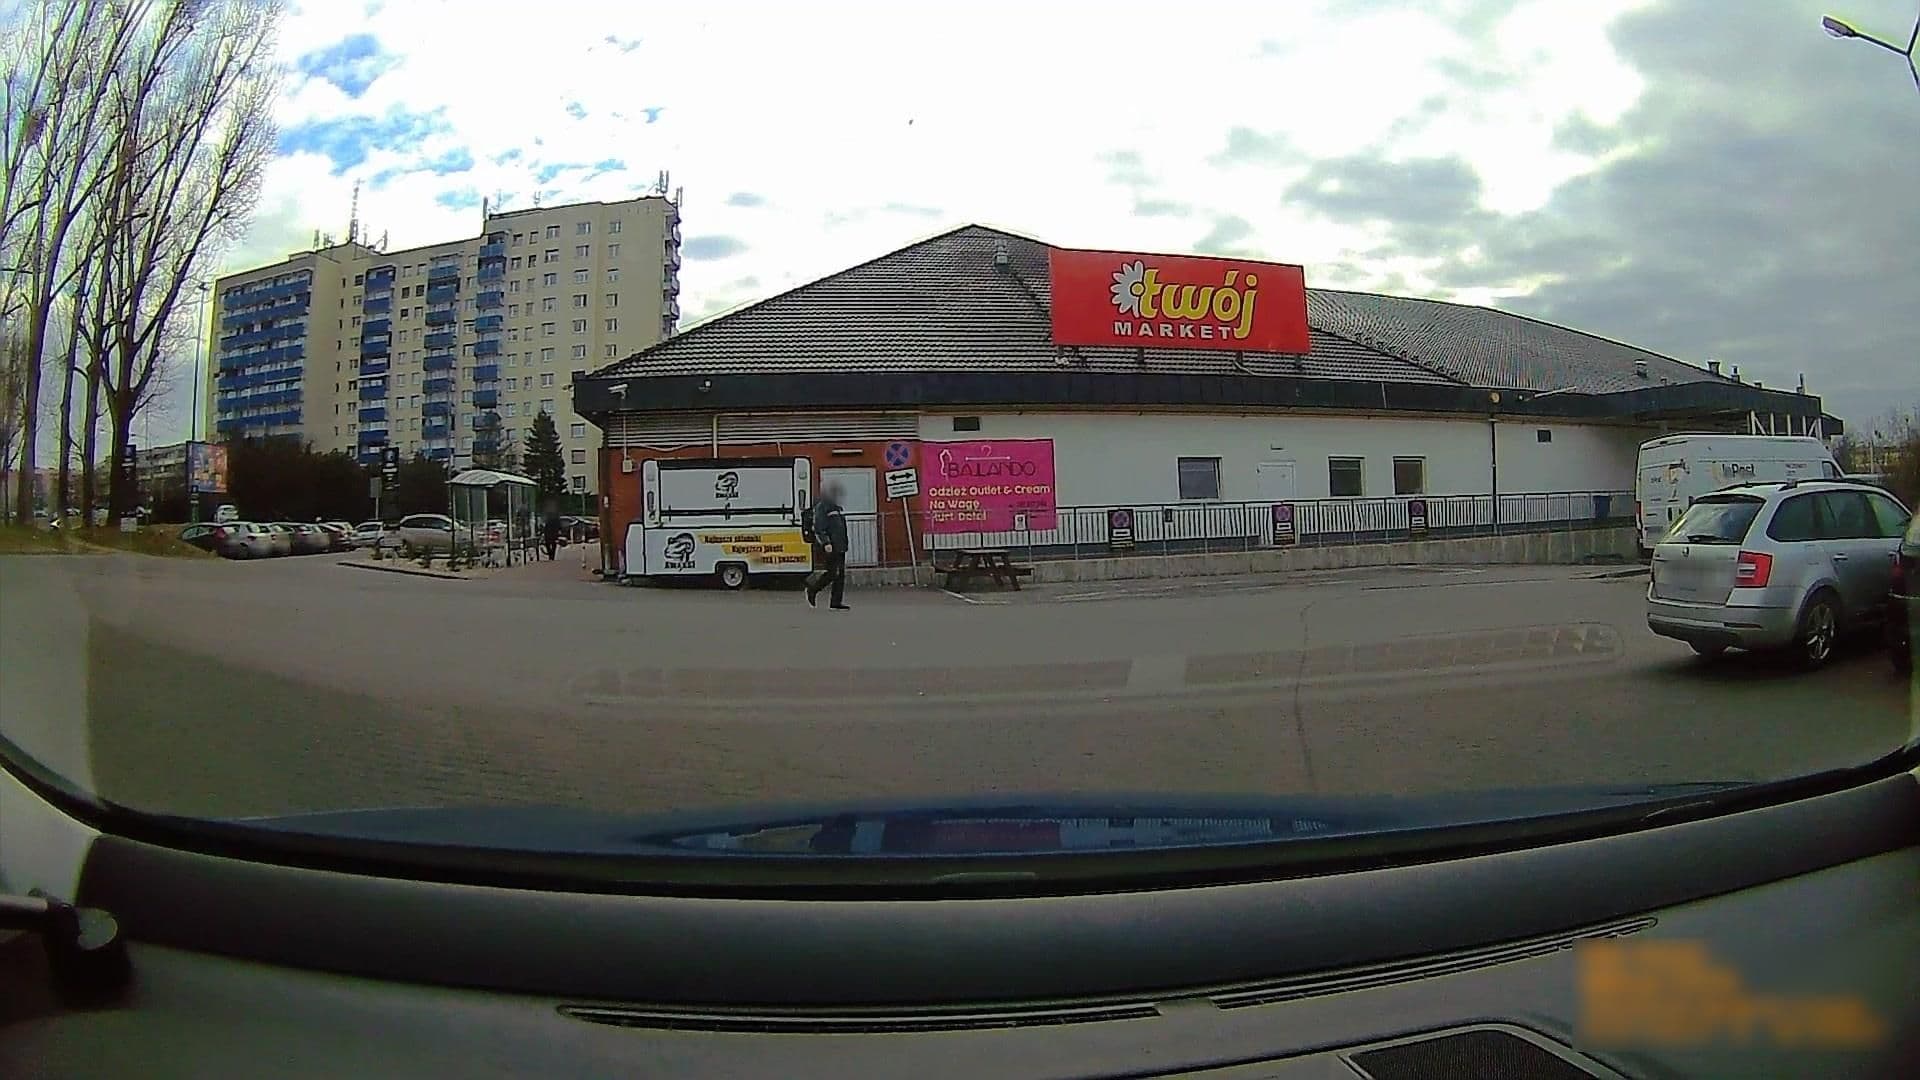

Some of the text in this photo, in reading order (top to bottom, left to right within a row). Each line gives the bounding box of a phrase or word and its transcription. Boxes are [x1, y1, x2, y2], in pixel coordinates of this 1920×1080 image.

[1140, 268, 1258, 339] twój
[1114, 321, 1231, 339] MARKET
[969, 485, 1001, 496] Outlet
[1003, 486, 1012, 495] &
[1014, 484, 1051, 495] Cream
[929, 499, 946, 510] Na
